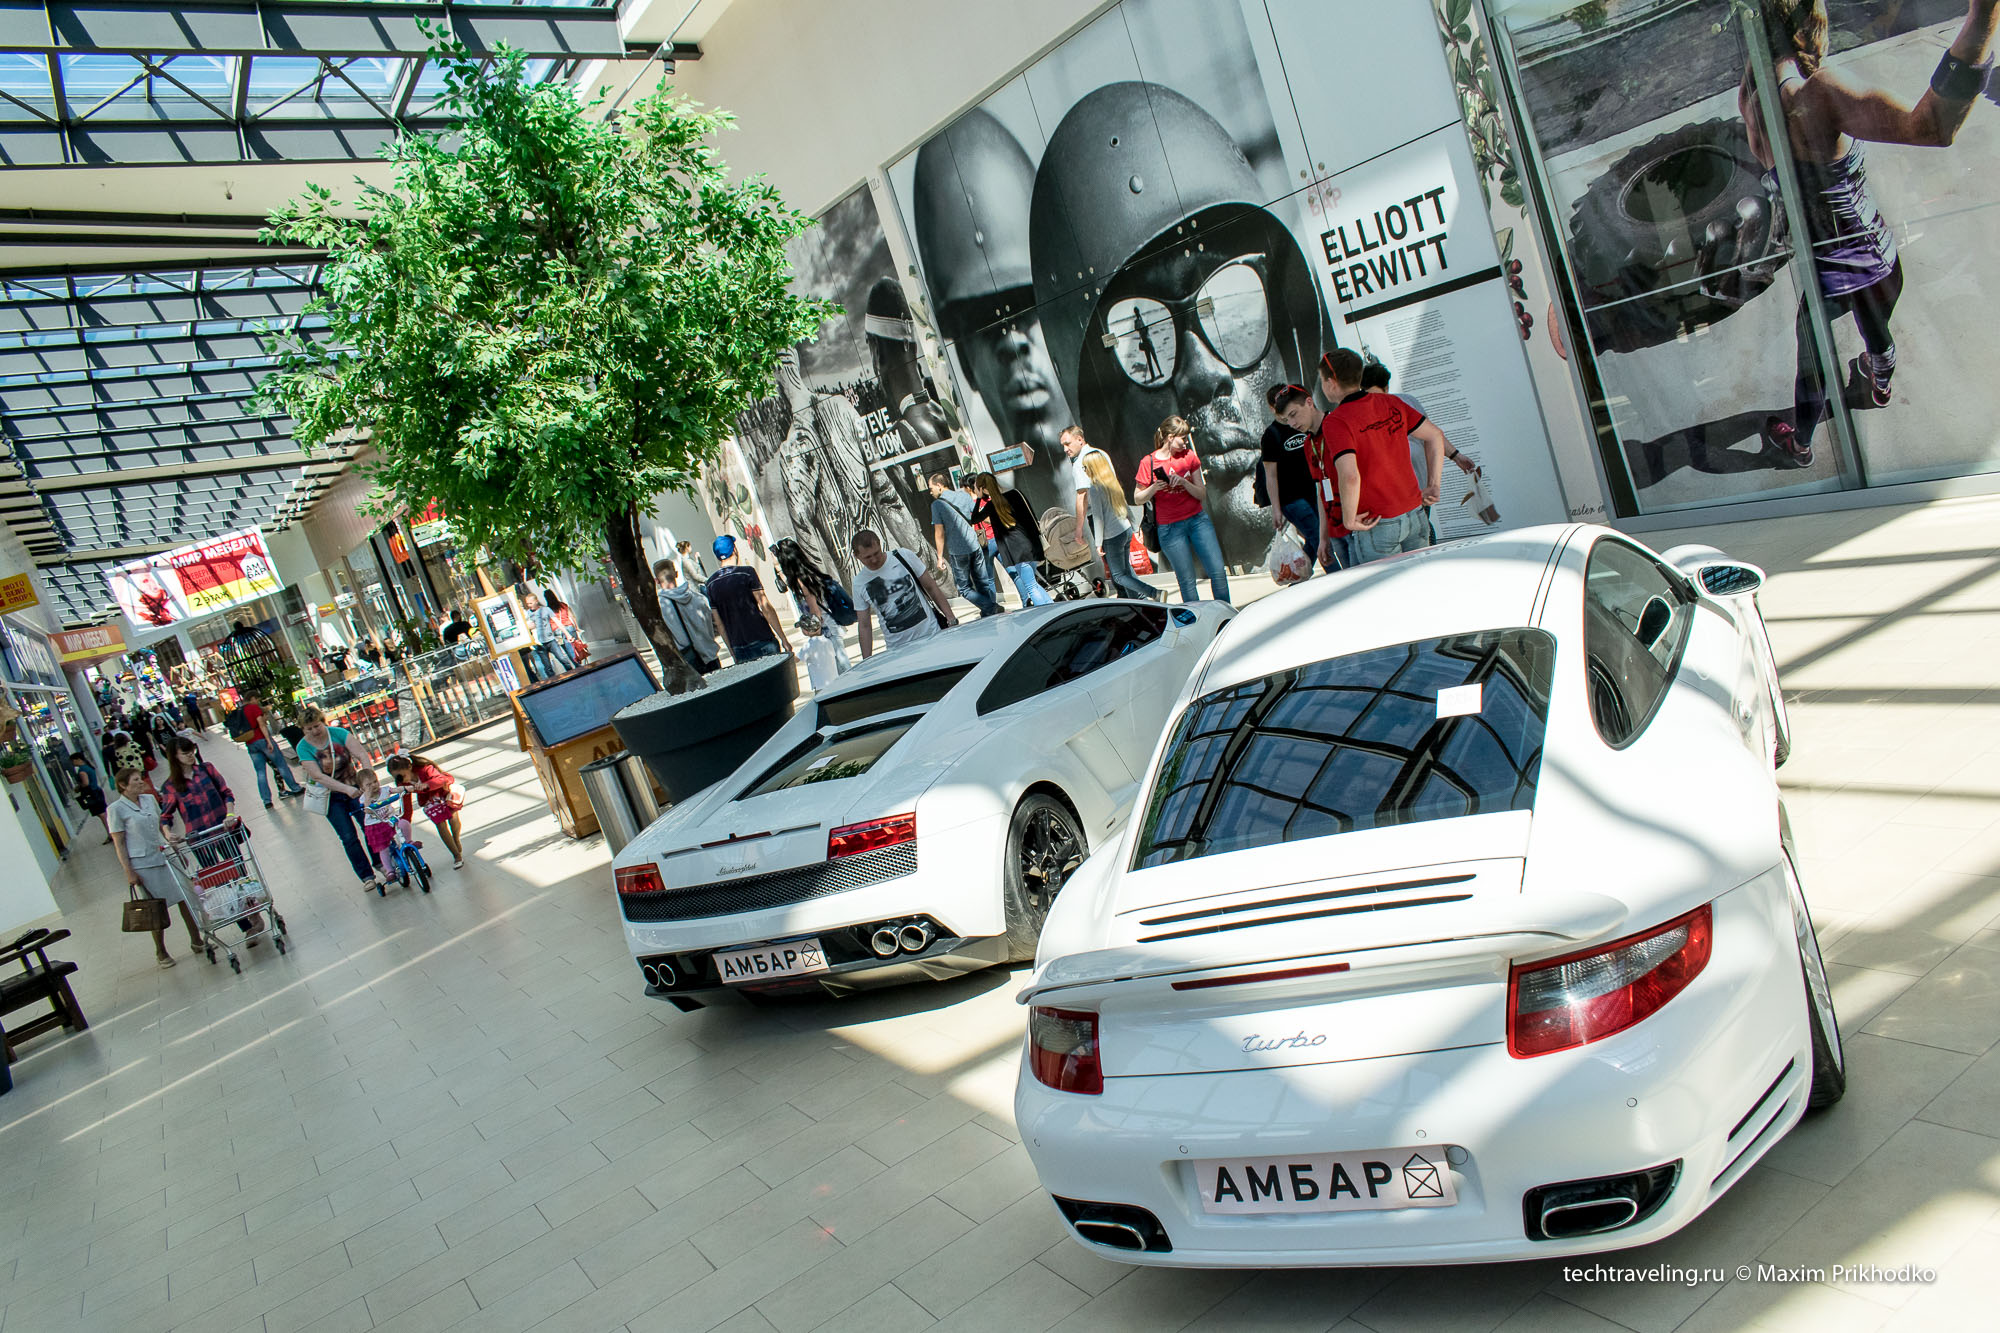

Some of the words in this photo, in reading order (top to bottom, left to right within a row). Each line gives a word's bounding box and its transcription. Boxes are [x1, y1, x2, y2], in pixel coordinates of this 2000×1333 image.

[1320, 186, 1446, 266] ELLIOTT
[1331, 232, 1448, 304] ERWITT
[855, 407, 893, 438] STEVE
[862, 429, 907, 461] BLOOM
[172, 551, 203, 569] МИР
[204, 536, 258, 560] МЕБЕЛИ
[246, 563, 261, 572] АМ
[247, 567, 267, 579] БАР
[3, 580, 25, 592] МОТО
[8, 592, 33, 604] СПОРТ
[194, 597, 202, 607] 2
[204, 591, 230, 605] ЭТАЖ
[64, 633, 83, 652] МИР
[81, 630, 113, 649] МЕБЕЛИ
[723, 949, 798, 978] АМБАР
[1241, 1030, 1327, 1053] turbo
[1214, 1161, 1392, 1203] АМБАР
